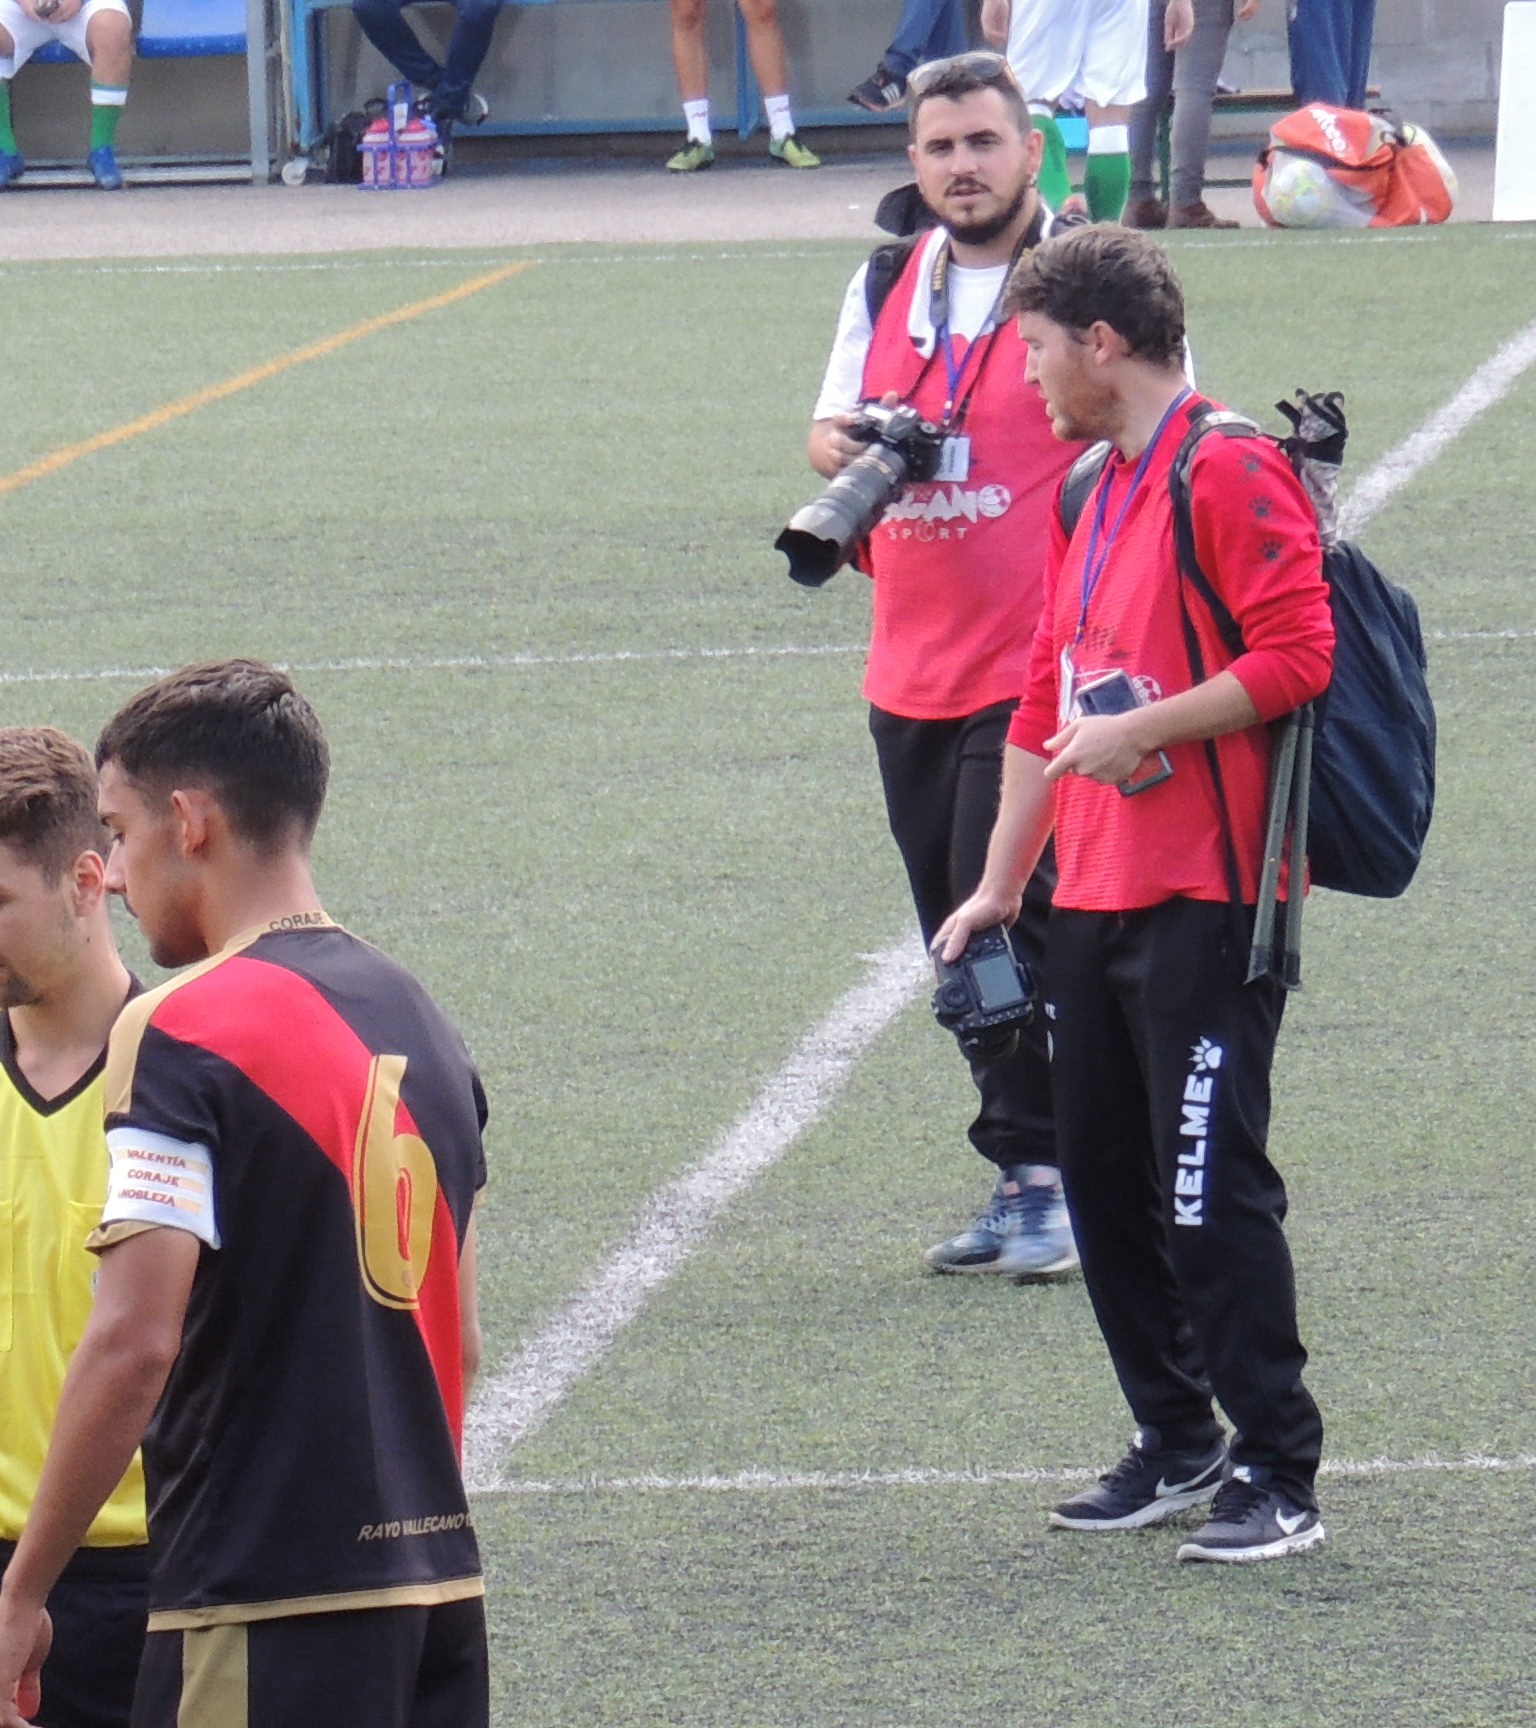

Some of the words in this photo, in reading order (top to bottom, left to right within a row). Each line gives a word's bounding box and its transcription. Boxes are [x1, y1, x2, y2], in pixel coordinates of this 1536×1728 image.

[887, 520, 968, 542] SPORT
[1174, 1074, 1214, 1226] KELME
[127, 1168, 180, 1187] CORAJE
[353, 1053, 438, 1310] 6
[119, 1188, 175, 1207] NOBLEZA
[356, 1520, 401, 1542] RAYO
